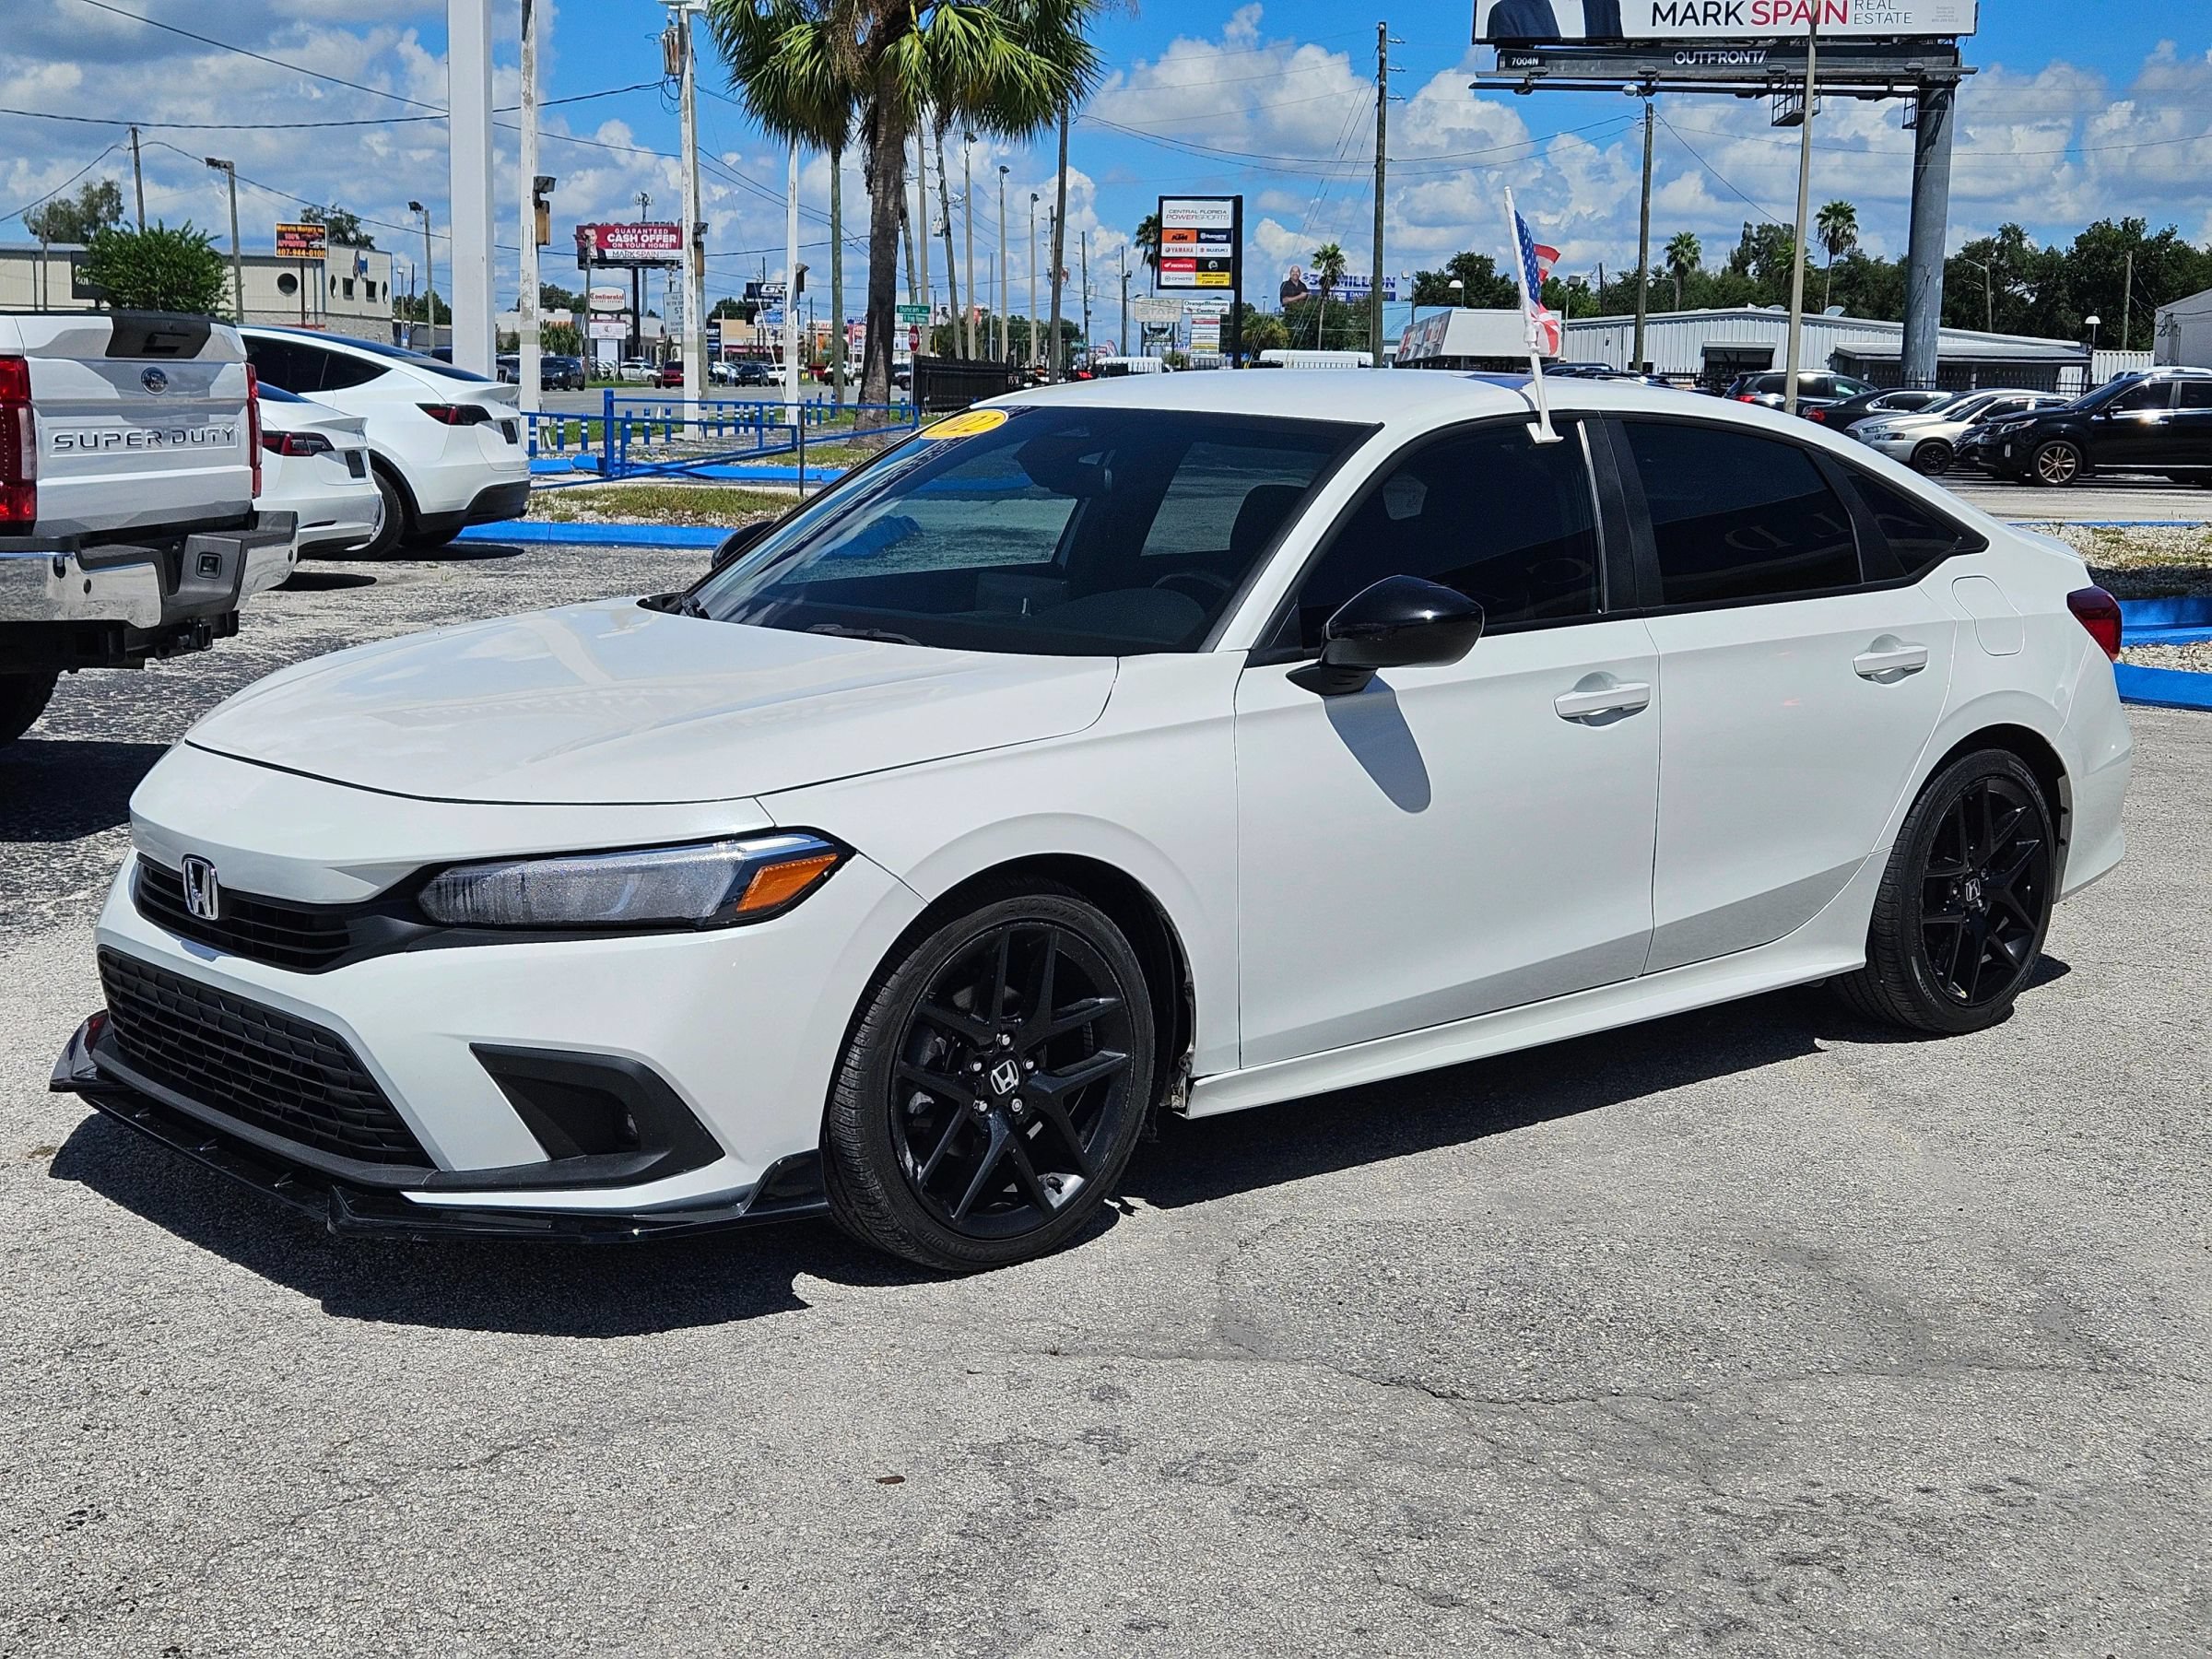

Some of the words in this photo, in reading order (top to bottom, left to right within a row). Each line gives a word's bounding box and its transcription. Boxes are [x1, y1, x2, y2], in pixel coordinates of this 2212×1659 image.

[1854, 0, 1896, 10] REAL
[1652, 1, 1745, 27] MARK
[1750, 0, 1848, 26] SPAIN
[1853, 12, 1912, 24] ESTATE
[1511, 57, 1539, 65] 7004N
[607, 234, 638, 242] CASH
[641, 234, 677, 242] OFFER
[590, 292, 624, 300] Continental
[899, 305, 920, 313] Duncan
[54, 433, 162, 450] SUPER
[171, 428, 236, 445] DUTY
